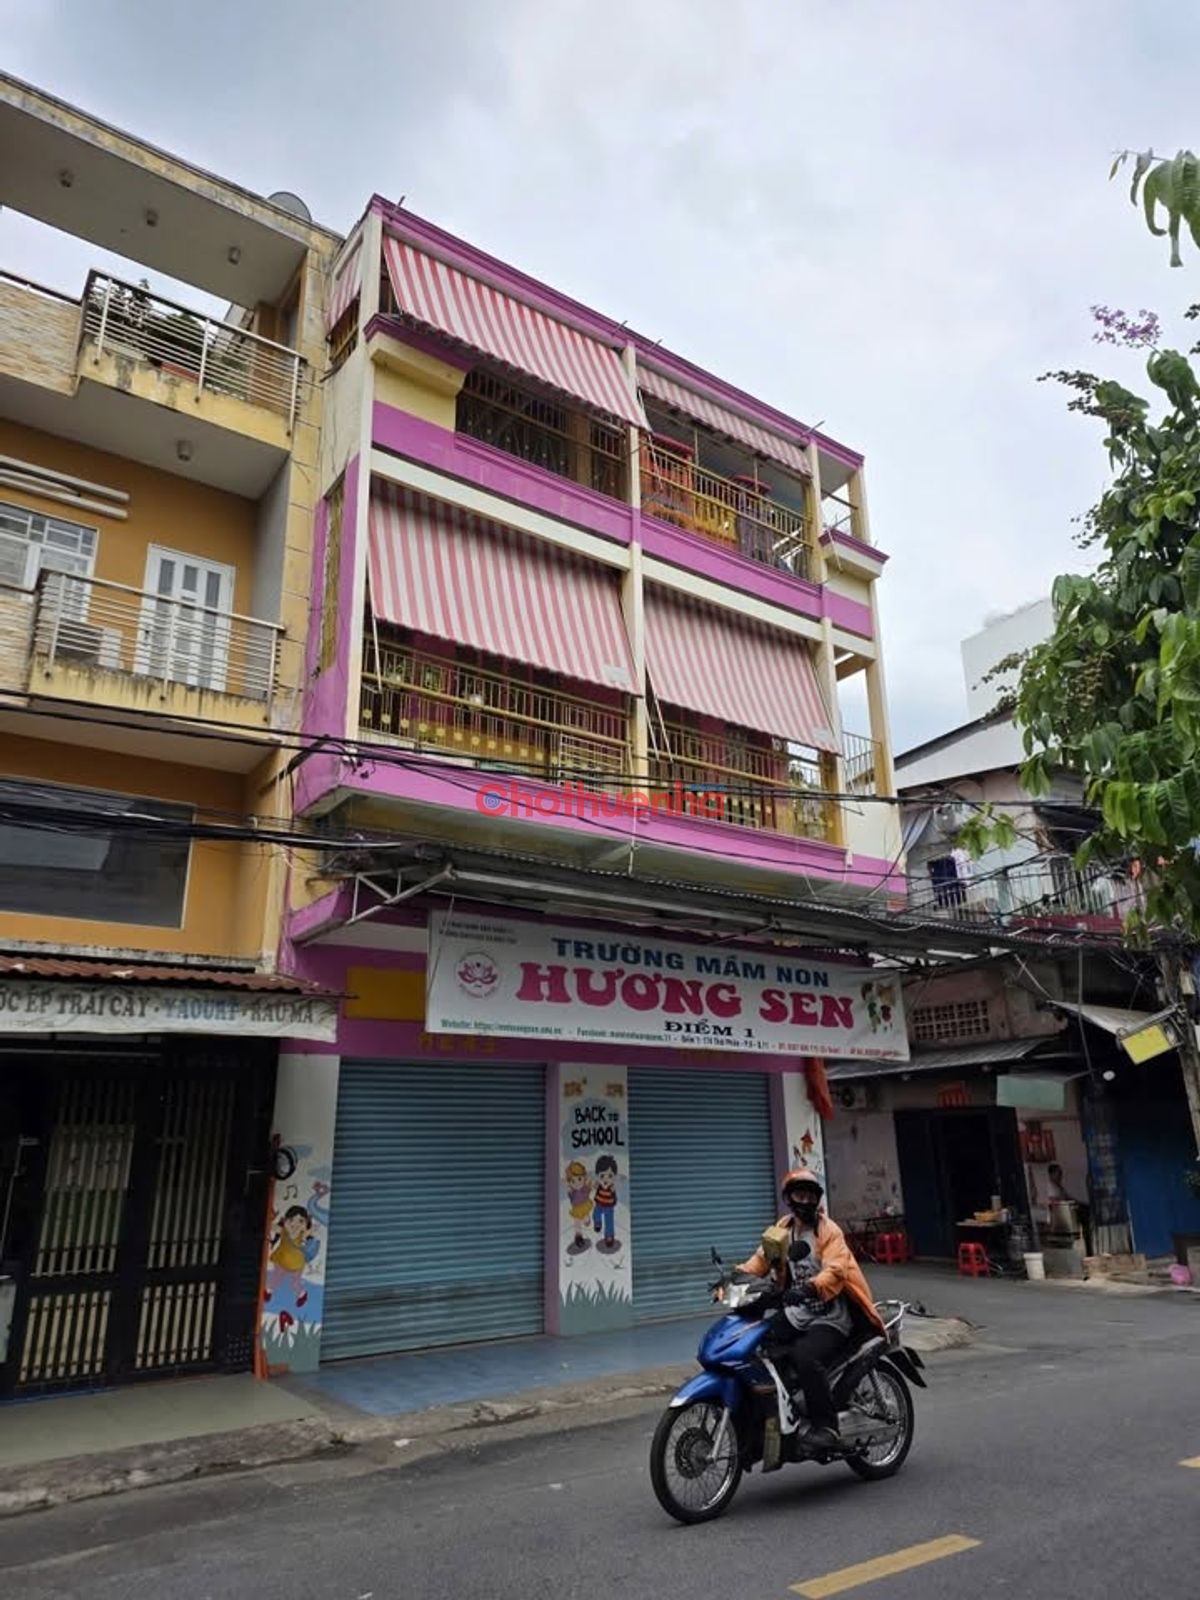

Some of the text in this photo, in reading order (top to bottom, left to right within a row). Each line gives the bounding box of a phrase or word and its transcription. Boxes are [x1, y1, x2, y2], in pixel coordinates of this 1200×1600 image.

[552, 938, 684, 970] TRƯỜNG
[777, 965, 829, 987] NON
[516, 962, 742, 1018] HƯƠNG
[759, 988, 854, 1029] SEN
[664, 1018, 732, 1037] ĐIỂM
[744, 1028, 756, 1039] 1
[575, 1105, 606, 1124] BACK
[571, 1125, 624, 1149] SCHOOL
